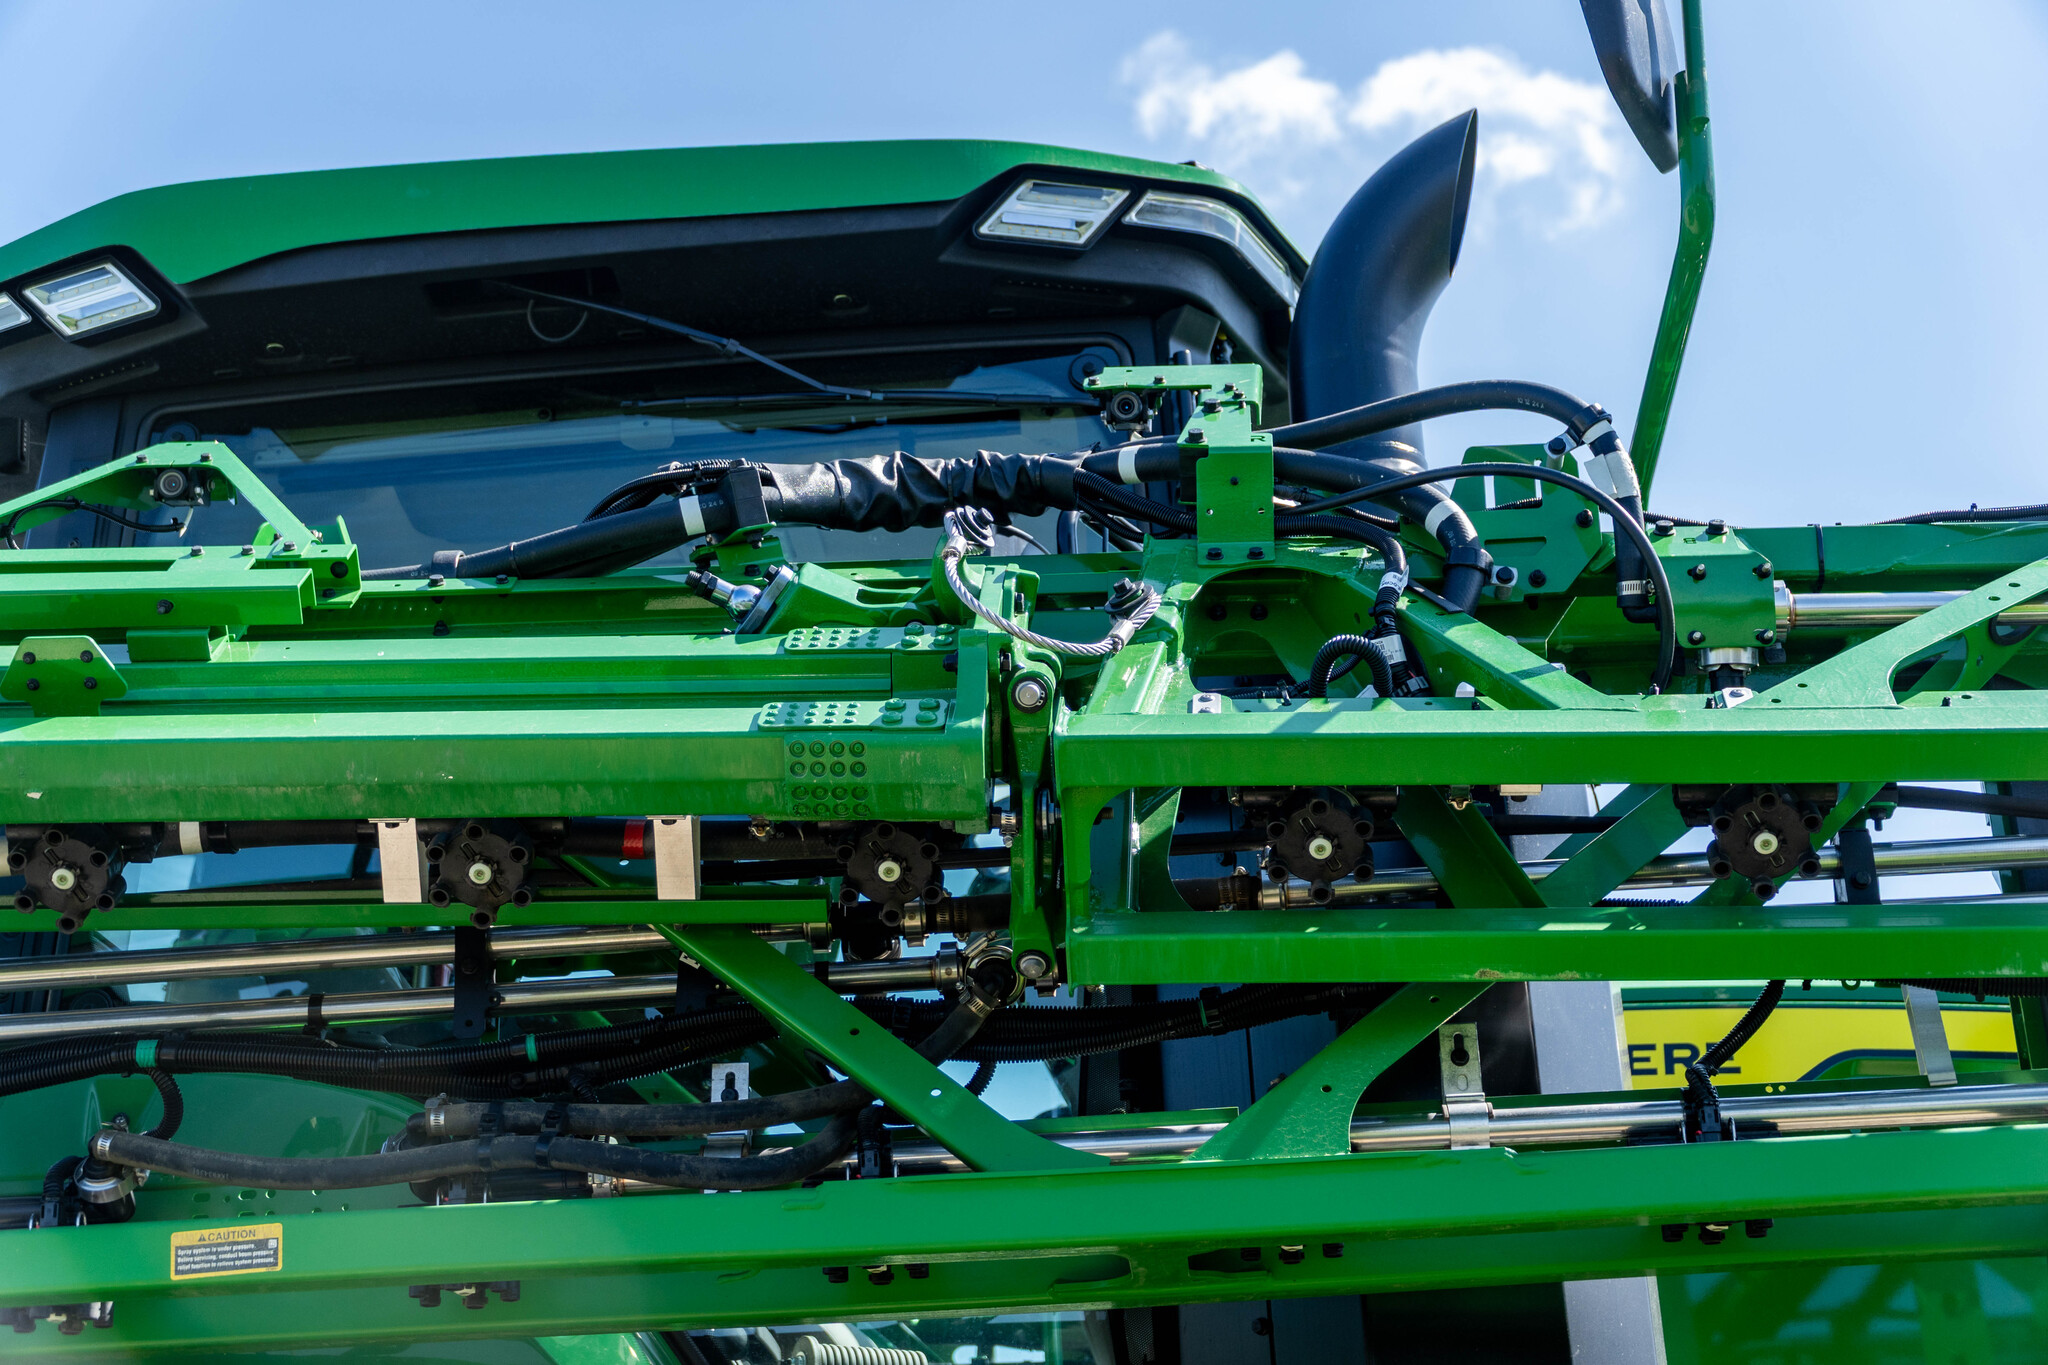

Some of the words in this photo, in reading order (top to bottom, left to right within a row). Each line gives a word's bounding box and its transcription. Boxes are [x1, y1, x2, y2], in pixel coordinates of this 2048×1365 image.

[208, 1229, 256, 1242] CAUTION
[193, 1246, 211, 1255] system
[217, 1244, 232, 1252] under
